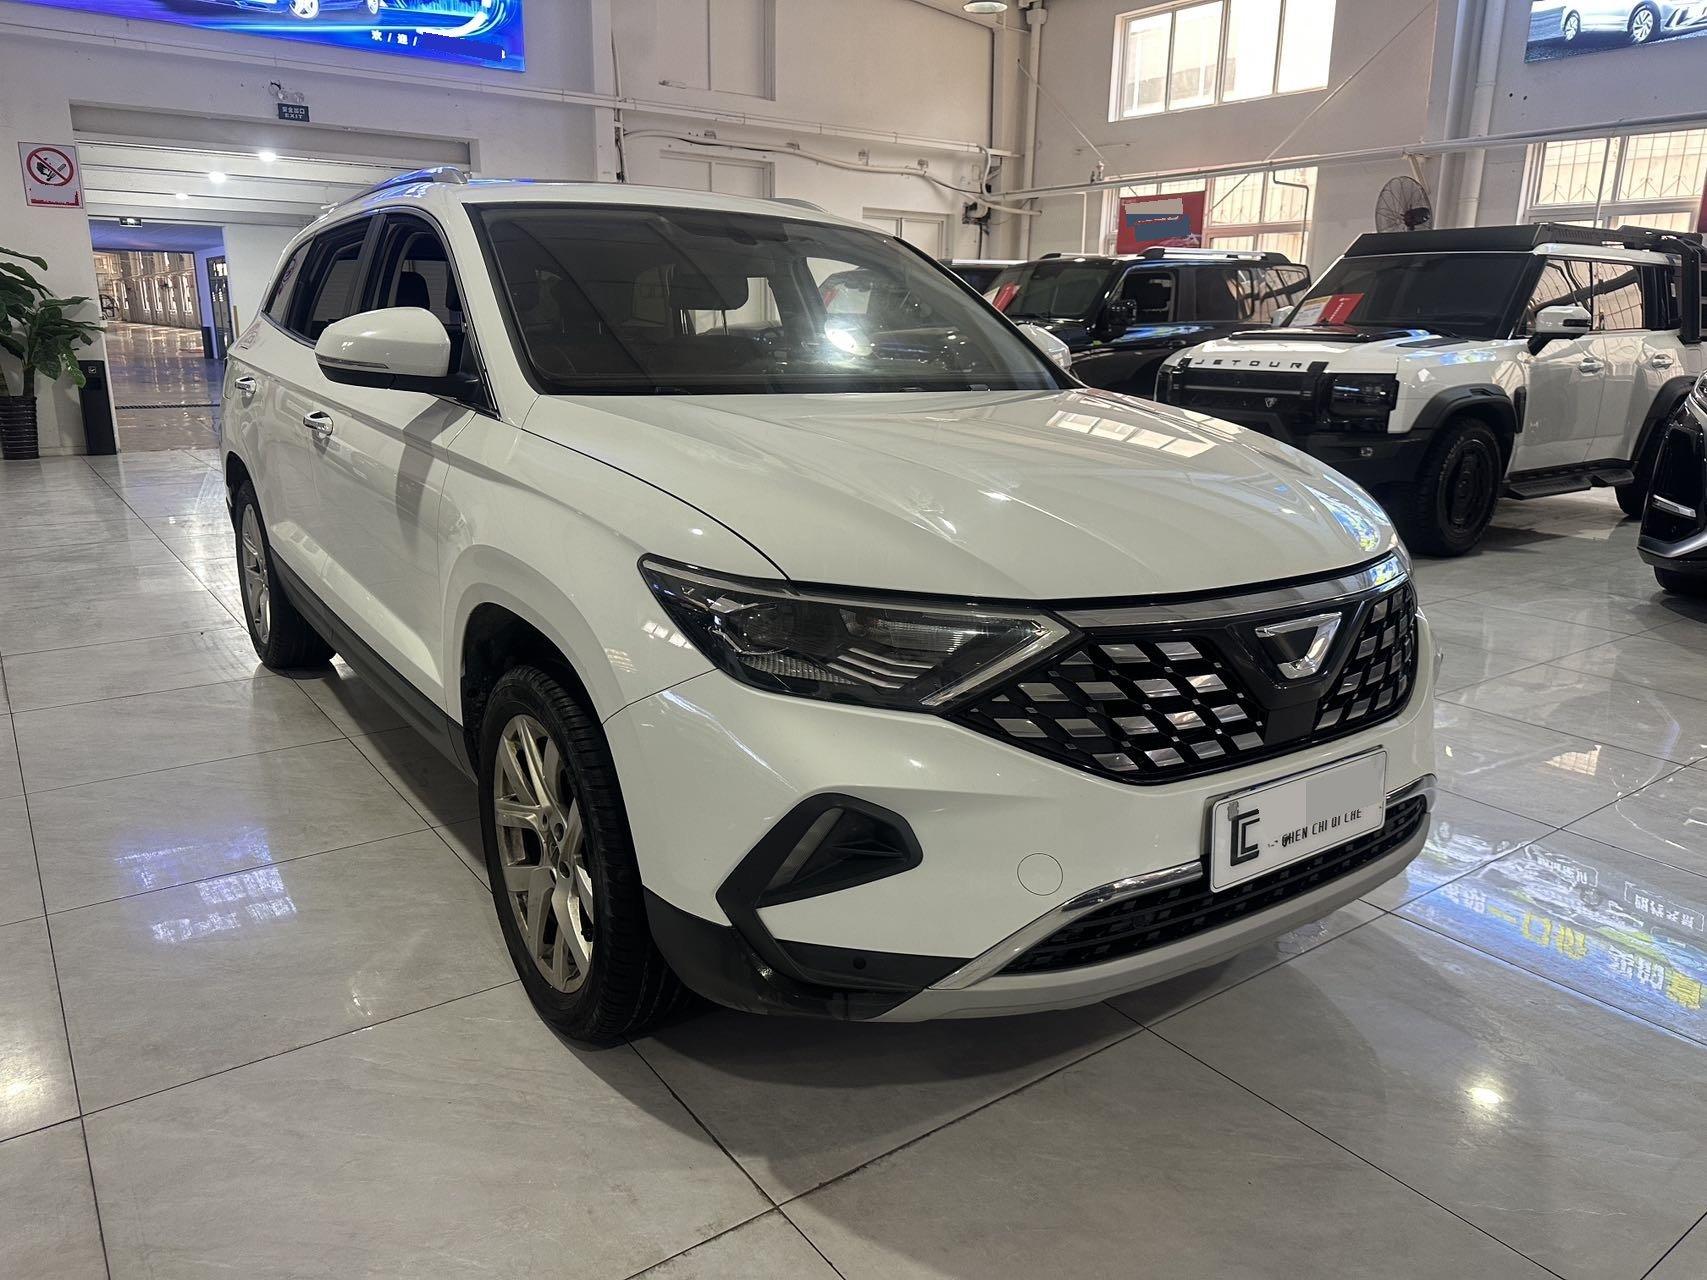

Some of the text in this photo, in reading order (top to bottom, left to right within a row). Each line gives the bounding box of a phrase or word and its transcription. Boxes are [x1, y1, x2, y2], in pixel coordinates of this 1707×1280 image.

[282, 106, 305, 114] 安全出口
[1194, 359, 1303, 369] JETOUR
[1312, 820, 1328, 835] CHI
